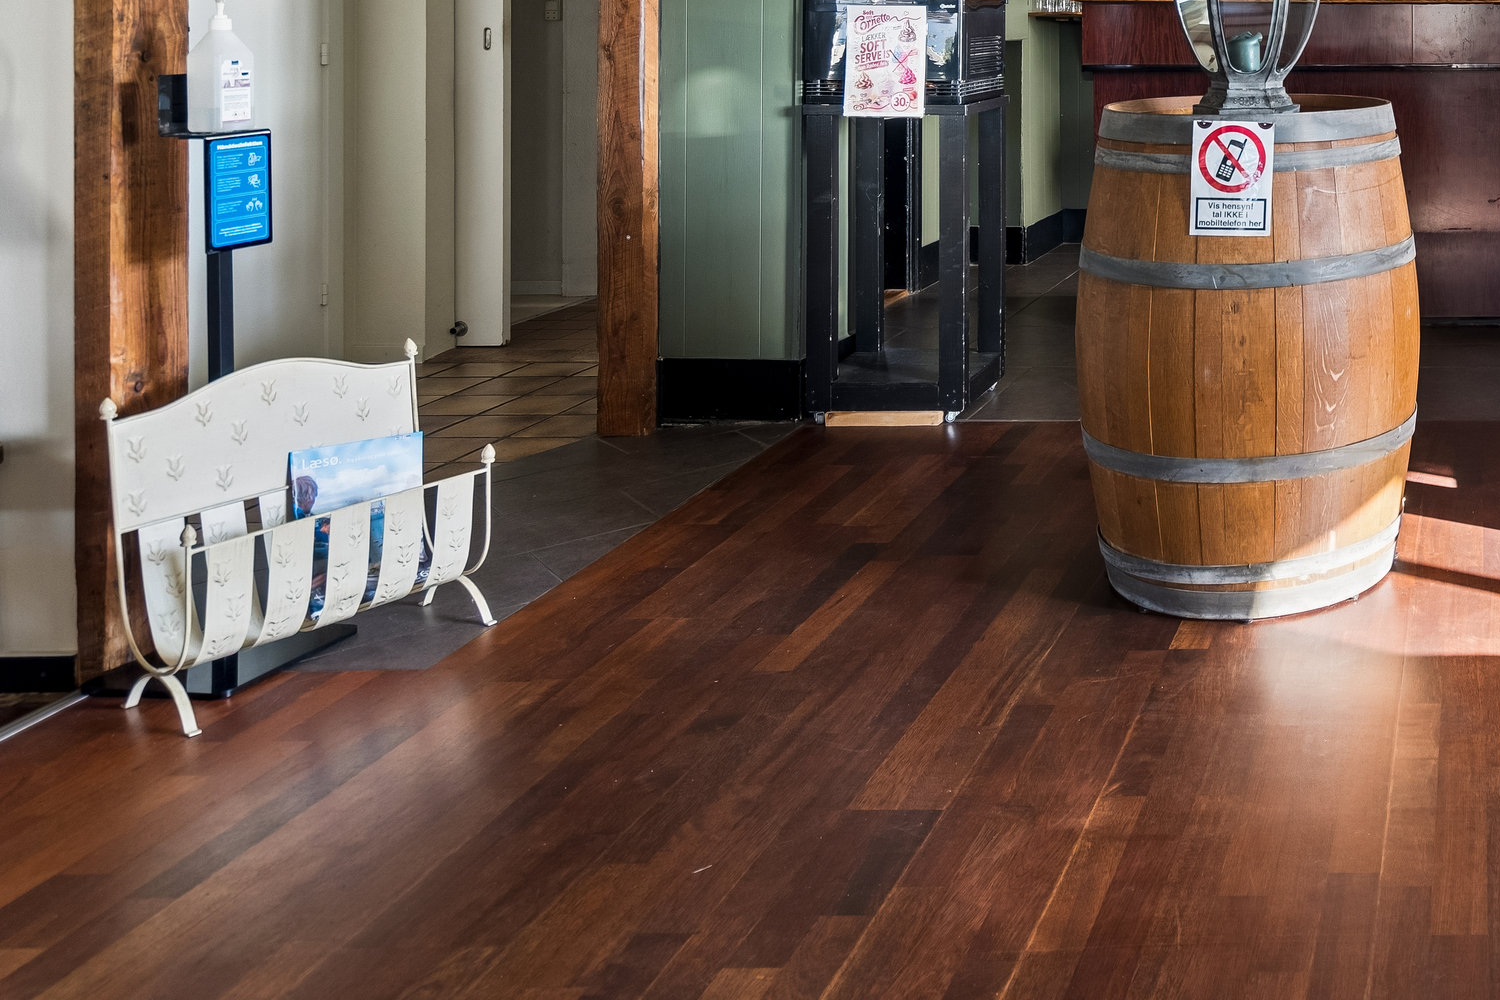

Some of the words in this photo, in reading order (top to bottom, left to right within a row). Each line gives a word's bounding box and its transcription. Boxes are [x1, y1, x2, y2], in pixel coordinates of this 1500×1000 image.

[860, 39, 887, 54] SOFT
[855, 51, 882, 65] SERVE
[1222, 202, 1254, 210] hensyn!
[1198, 219, 1246, 227] mobiltelefon
